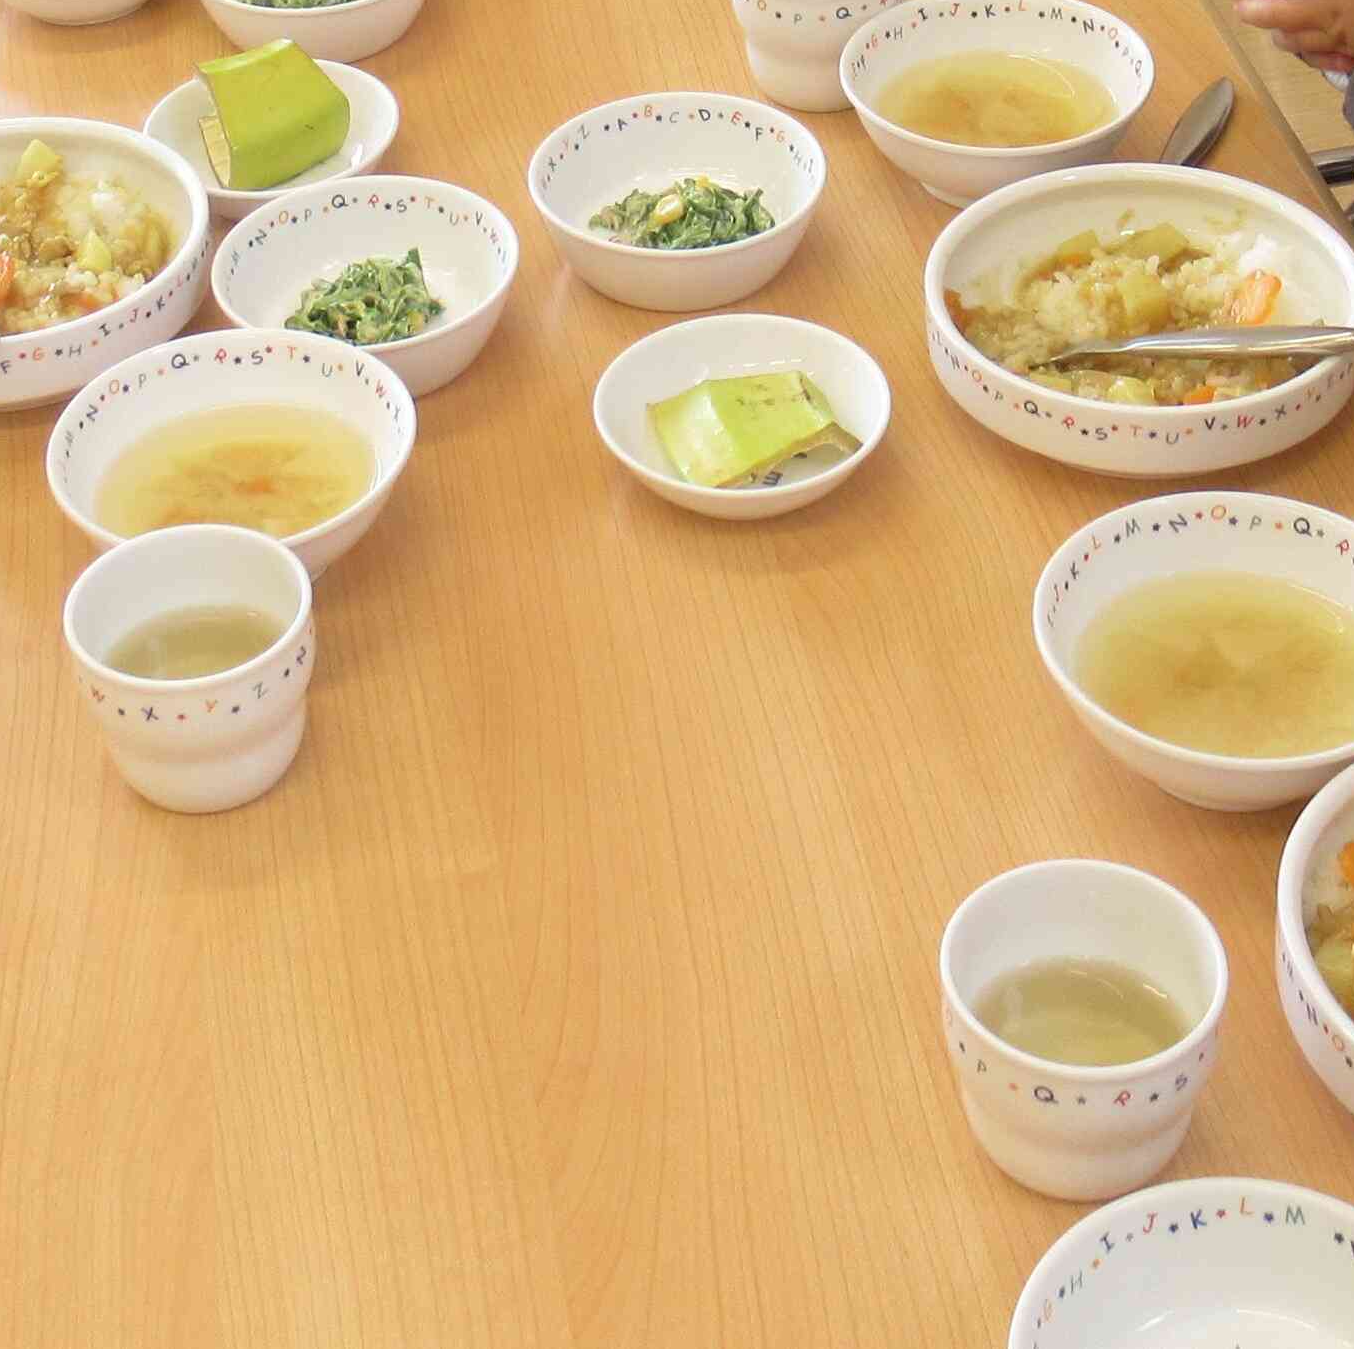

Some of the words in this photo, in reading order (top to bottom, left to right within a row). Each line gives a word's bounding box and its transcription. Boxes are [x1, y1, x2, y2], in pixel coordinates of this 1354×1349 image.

[757, 0, 767, 11] O
[794, 13, 802, 24] P
[836, 6, 852, 20] Q
[893, 27, 903, 40] H
[918, 8, 929, 21] I
[950, 2, 960, 16] J
[985, 4, 996, 17] K
[1018, 0, 1027, 12] L
[1050, 8, 1063, 20] M
[1083, 19, 1095, 34] N
[1108, 27, 1118, 39] O
[1134, 60, 1142, 75] Q
[579, 124, 590, 140] Z
[617, 117, 628, 131] A
[643, 105, 653, 117] B
[669, 111, 680, 124] C
[698, 108, 711, 121] D
[730, 111, 743, 125] E
[754, 127, 763, 141] F
[255, 229, 267, 245] N
[278, 210, 289, 224] O
[304, 208, 312, 222] P
[331, 194, 348, 208] Q
[367, 194, 380, 207] R
[397, 200, 407, 213] S
[423, 196, 434, 208] T
[449, 212, 460, 225] U
[475, 210, 484, 225] V
[0, 359, 12, 375] F
[33, 347, 44, 361] G
[69, 344, 82, 356] H
[98, 323, 111, 337] I
[129, 308, 140, 323] J
[156, 296, 166, 311] K
[86, 405, 99, 421] N
[108, 379, 120, 395] O
[138, 373, 147, 389] P
[171, 353, 190, 370] Q
[214, 348, 227, 363] R
[251, 350, 264, 365] S
[286, 346, 296, 360] T
[321, 362, 333, 377] U
[355, 360, 364, 376] V
[375, 382, 387, 398] W
[971, 369, 982, 382] O
[1023, 400, 1041, 418] Q
[1063, 415, 1075, 429] R
[1094, 427, 1108, 440] S
[1131, 424, 1143, 437] T
[1166, 433, 1179, 445] U
[1204, 416, 1216, 430] V
[1237, 414, 1254, 428] W
[1275, 405, 1287, 420] X
[1070, 562, 1080, 580] K
[1092, 535, 1102, 551] L
[1126, 518, 1141, 537] M
[1168, 513, 1188, 533] N
[1211, 505, 1227, 523] O
[1249, 516, 1262, 532] P
[1293, 517, 1312, 537] Q
[1336, 539, 1351, 555] R
[141, 706, 159, 722] X
[205, 699, 218, 712] Y
[1331, 1034, 1345, 1052] O
[1034, 1086, 1059, 1104] Q
[1114, 1090, 1131, 1106] R
[1070, 1270, 1083, 1295] H
[1099, 1231, 1115, 1254] I
[1142, 1211, 1158, 1235] J
[1189, 1208, 1207, 1230] K
[1239, 1197, 1253, 1215] L
[1285, 1205, 1306, 1226] M
